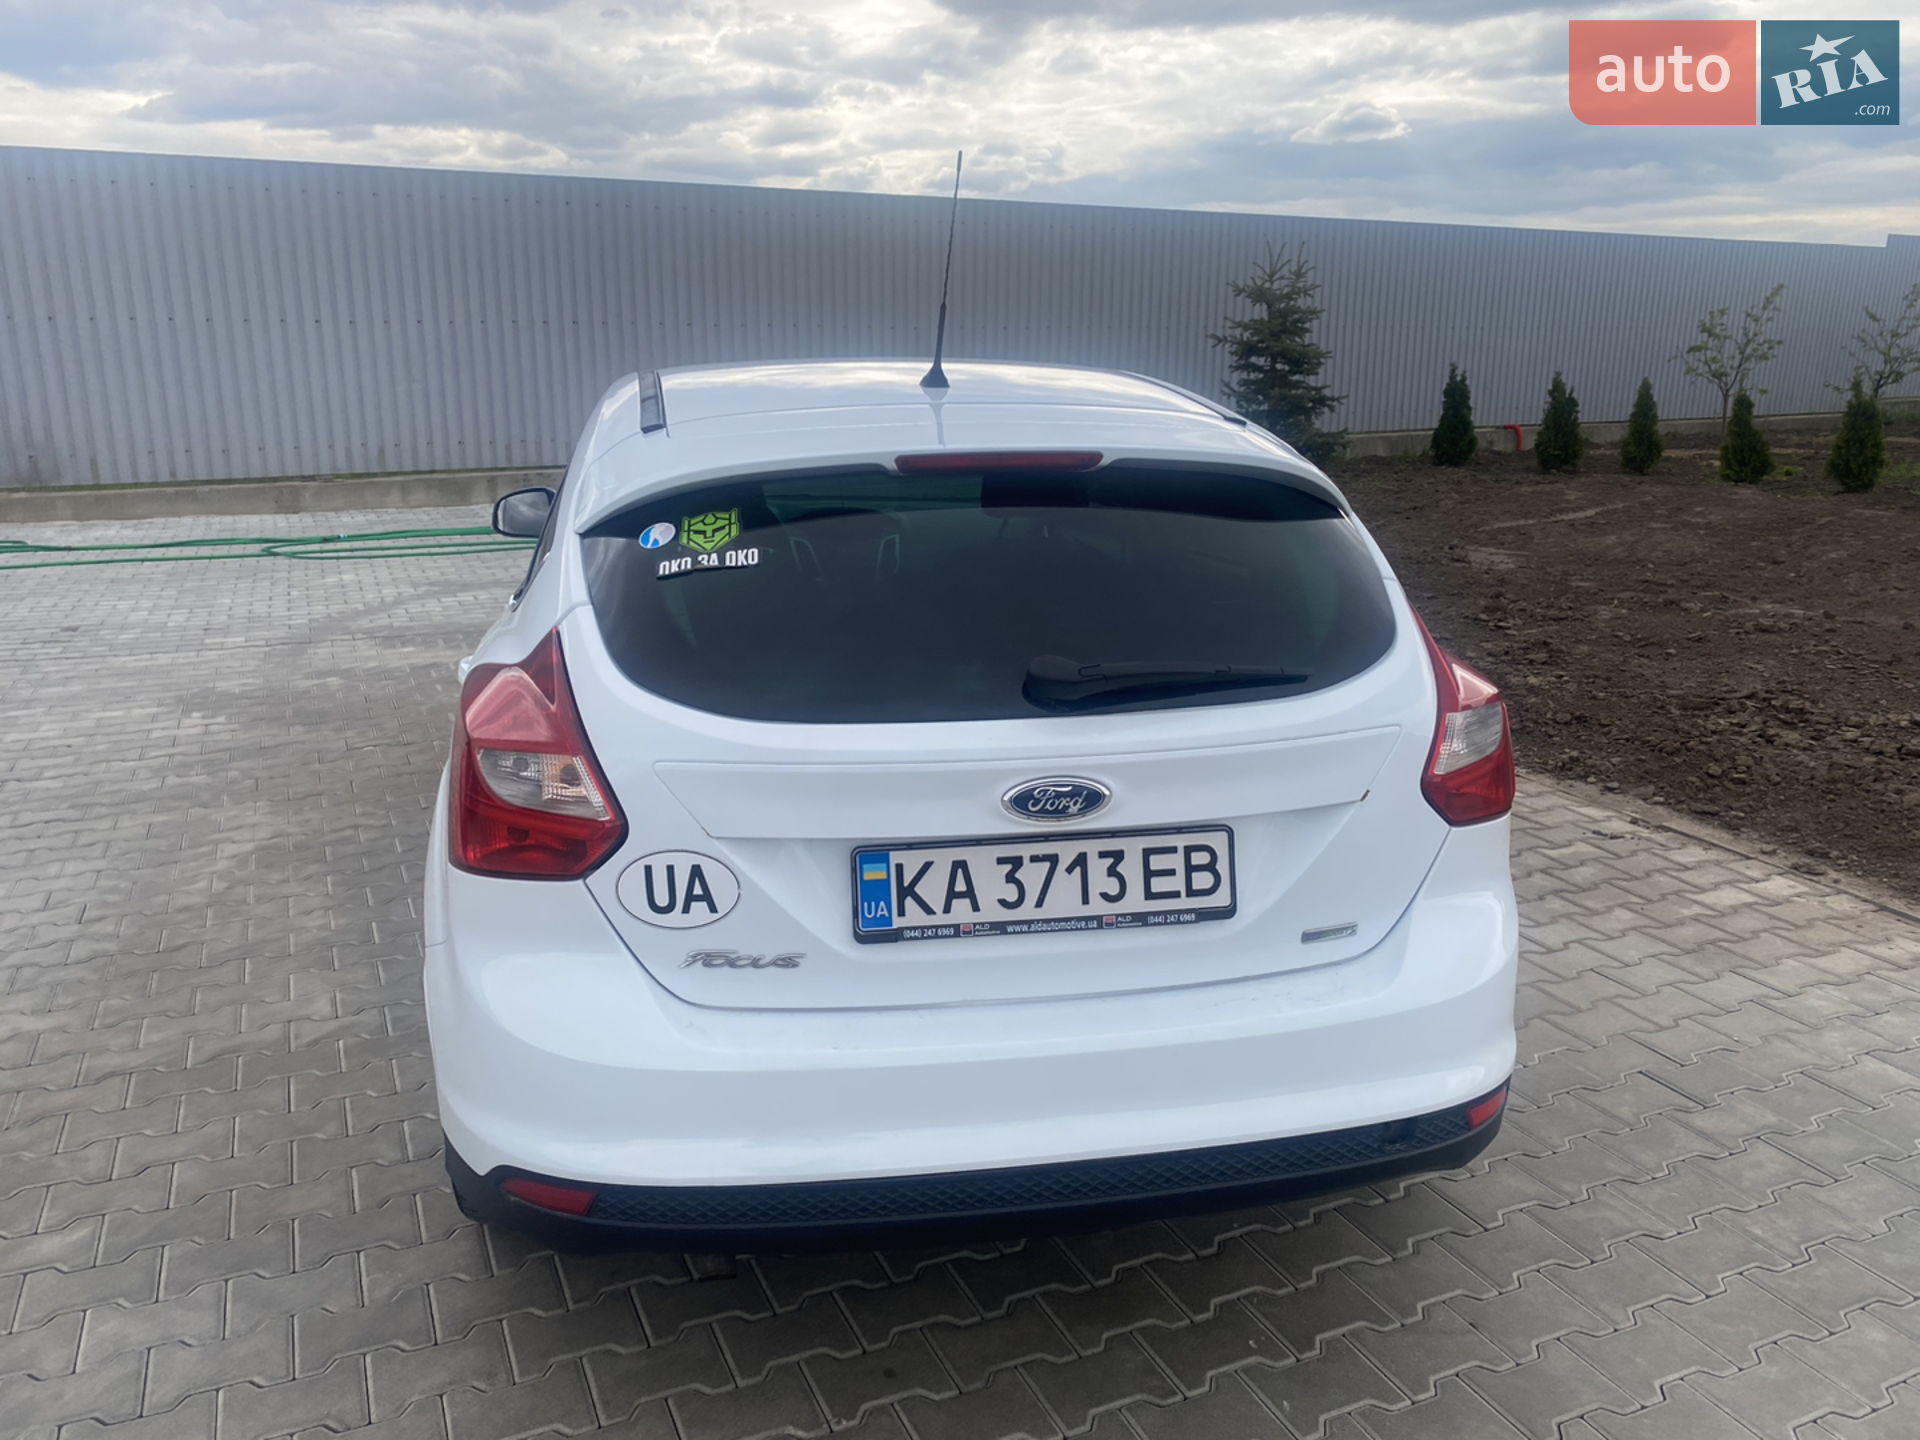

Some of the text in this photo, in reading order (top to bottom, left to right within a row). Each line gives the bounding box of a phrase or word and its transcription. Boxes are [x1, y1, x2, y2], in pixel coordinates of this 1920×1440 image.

[1028, 786, 1087, 812] Ford
[643, 864, 719, 915] UA
[894, 844, 1222, 917] KA 3713 EB
[864, 900, 889, 919] UA
[1147, 916, 1165, 924] (044)
[1179, 913, 1196, 922] 6969
[903, 927, 954, 939] (044) 247 6969
[1006, 919, 1098, 933] www.aldautomotive.ua
